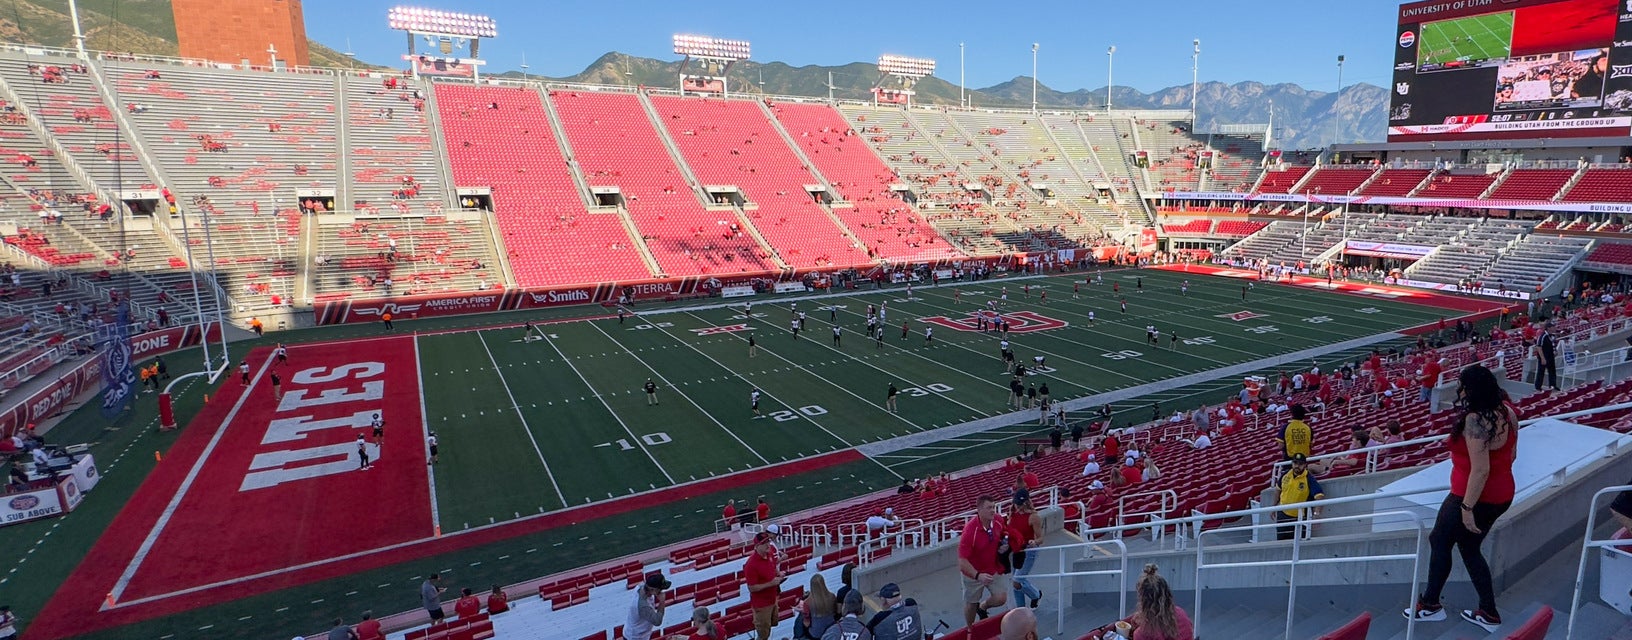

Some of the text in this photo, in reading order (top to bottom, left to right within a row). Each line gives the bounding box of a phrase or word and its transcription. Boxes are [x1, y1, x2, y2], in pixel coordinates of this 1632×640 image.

[1402, 0, 1492, 17] UNIVERSITY OF UTAH
[1590, 204, 1624, 212] BUILDING
[425, 295, 497, 308] AMERICA FIRST
[548, 289, 589, 303] Smith's
[132, 334, 170, 355] ZONE
[1101, 349, 1144, 360] 50
[901, 382, 954, 398] 30
[32, 381, 72, 421] RED ZONE
[768, 404, 828, 423] 20
[238, 361, 386, 492] UTES
[615, 431, 673, 452] 10
[6, 511, 25, 523] SUB
